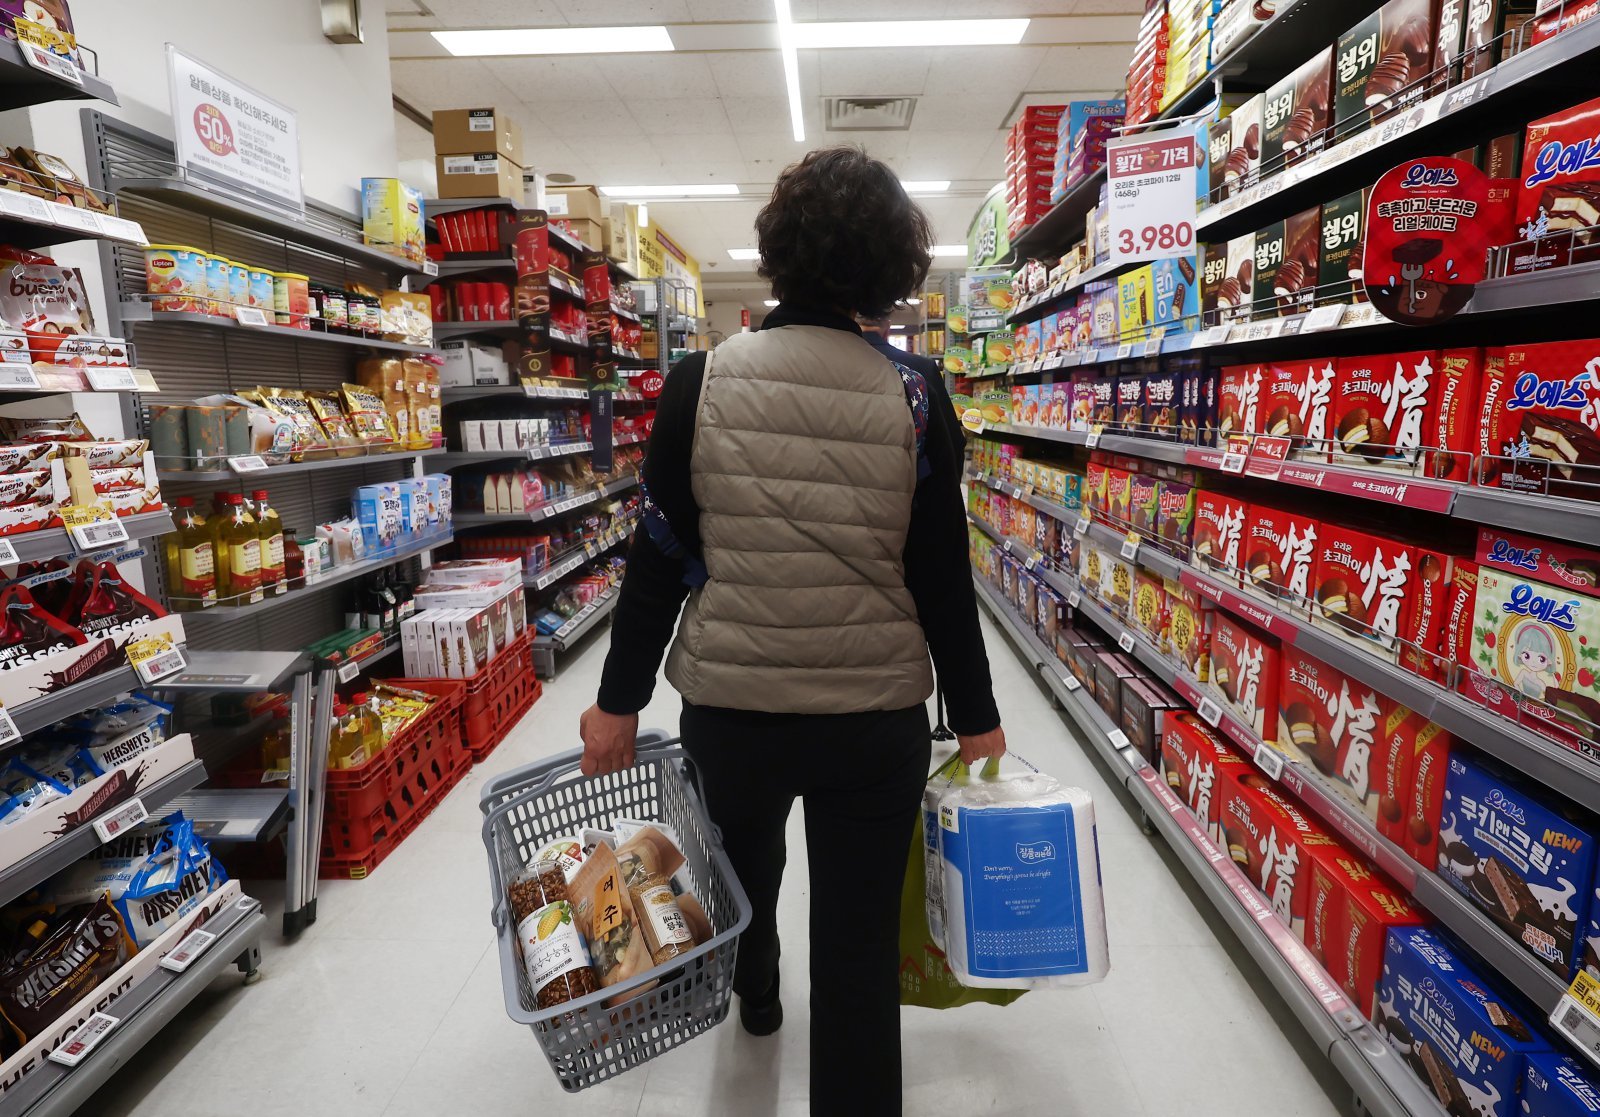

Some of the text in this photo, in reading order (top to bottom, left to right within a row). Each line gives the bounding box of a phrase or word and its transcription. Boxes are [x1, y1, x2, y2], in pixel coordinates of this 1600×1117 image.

[1337, 33, 1377, 83] 쉘위
[189, 73, 231, 106] 알뜰상품
[234, 96, 288, 133] 확인해주세요
[1265, 89, 1293, 129] 쉘위
[199, 111, 232, 147] 50%
[1115, 154, 1143, 174] 월간
[1161, 146, 1189, 167] 가격
[1115, 174, 1181, 190] 오리온 초코파이 12입
[1401, 163, 1459, 188] 오예스
[1115, 189, 1140, 198] (468g)
[1377, 199, 1477, 217] 촉촉하고 부드러운
[1118, 222, 1192, 255] 3,980
[1323, 211, 1359, 250] 쉘위
[1393, 216, 1457, 232] 리얼 케이크
[1255, 238, 1283, 270] 쉘위
[1205, 257, 1226, 284] 쉘위
[10, 277, 65, 297] bueno
[1342, 379, 1382, 397] 초코파이
[1352, 369, 1372, 378] 오리온
[1271, 382, 1299, 397] 초코파이
[1506, 372, 1590, 411] 오예스
[1438, 377, 1458, 452] 오리온 초코파이
[1451, 398, 1459, 418] 1974
[1480, 378, 1503, 456] 오리온 초코파이
[89, 449, 114, 460] bueno
[1295, 471, 1315, 482] 초코파이
[1131, 483, 1154, 506] 빅파이
[1160, 490, 1187, 519] 빅파이
[1367, 483, 1394, 495] 초코파이
[1395, 484, 1408, 500] 情
[1198, 508, 1219, 525] 초코파이
[1259, 518, 1273, 528] 오리온
[1252, 526, 1281, 546] 초코파이
[1333, 541, 1352, 553] 오리온
[1323, 550, 1362, 572] 초코파이
[1487, 539, 1541, 571] 오예스
[1415, 578, 1432, 648] 오리온 초코파이
[1450, 588, 1469, 632] 초코파이
[1503, 583, 1581, 633] 오예스
[1217, 628, 1237, 656] 초코파이
[1299, 660, 1318, 676] 오리온
[1289, 667, 1328, 704] 초코파이
[102, 732, 150, 764] HERSHEY'S
[1388, 733, 1403, 773] 초코파이
[1415, 751, 1434, 790] 초코파이
[82, 774, 119, 820] HERSHEY'S
[1485, 789, 1526, 825] 오예스
[1228, 799, 1258, 839] 초코파이
[1460, 795, 1553, 876] 쿠키앤크림
[1542, 828, 1583, 854] NEW!
[1019, 845, 1052, 858] 잘풀리는집
[18, 914, 118, 1008] HERSHEY'S
[1419, 977, 1456, 1021] 오예스
[1574, 981, 1590, 1001] 퀵
[1397, 974, 1480, 1075] 쿠키앤크림
[1470, 1030, 1506, 1062] NEW!
